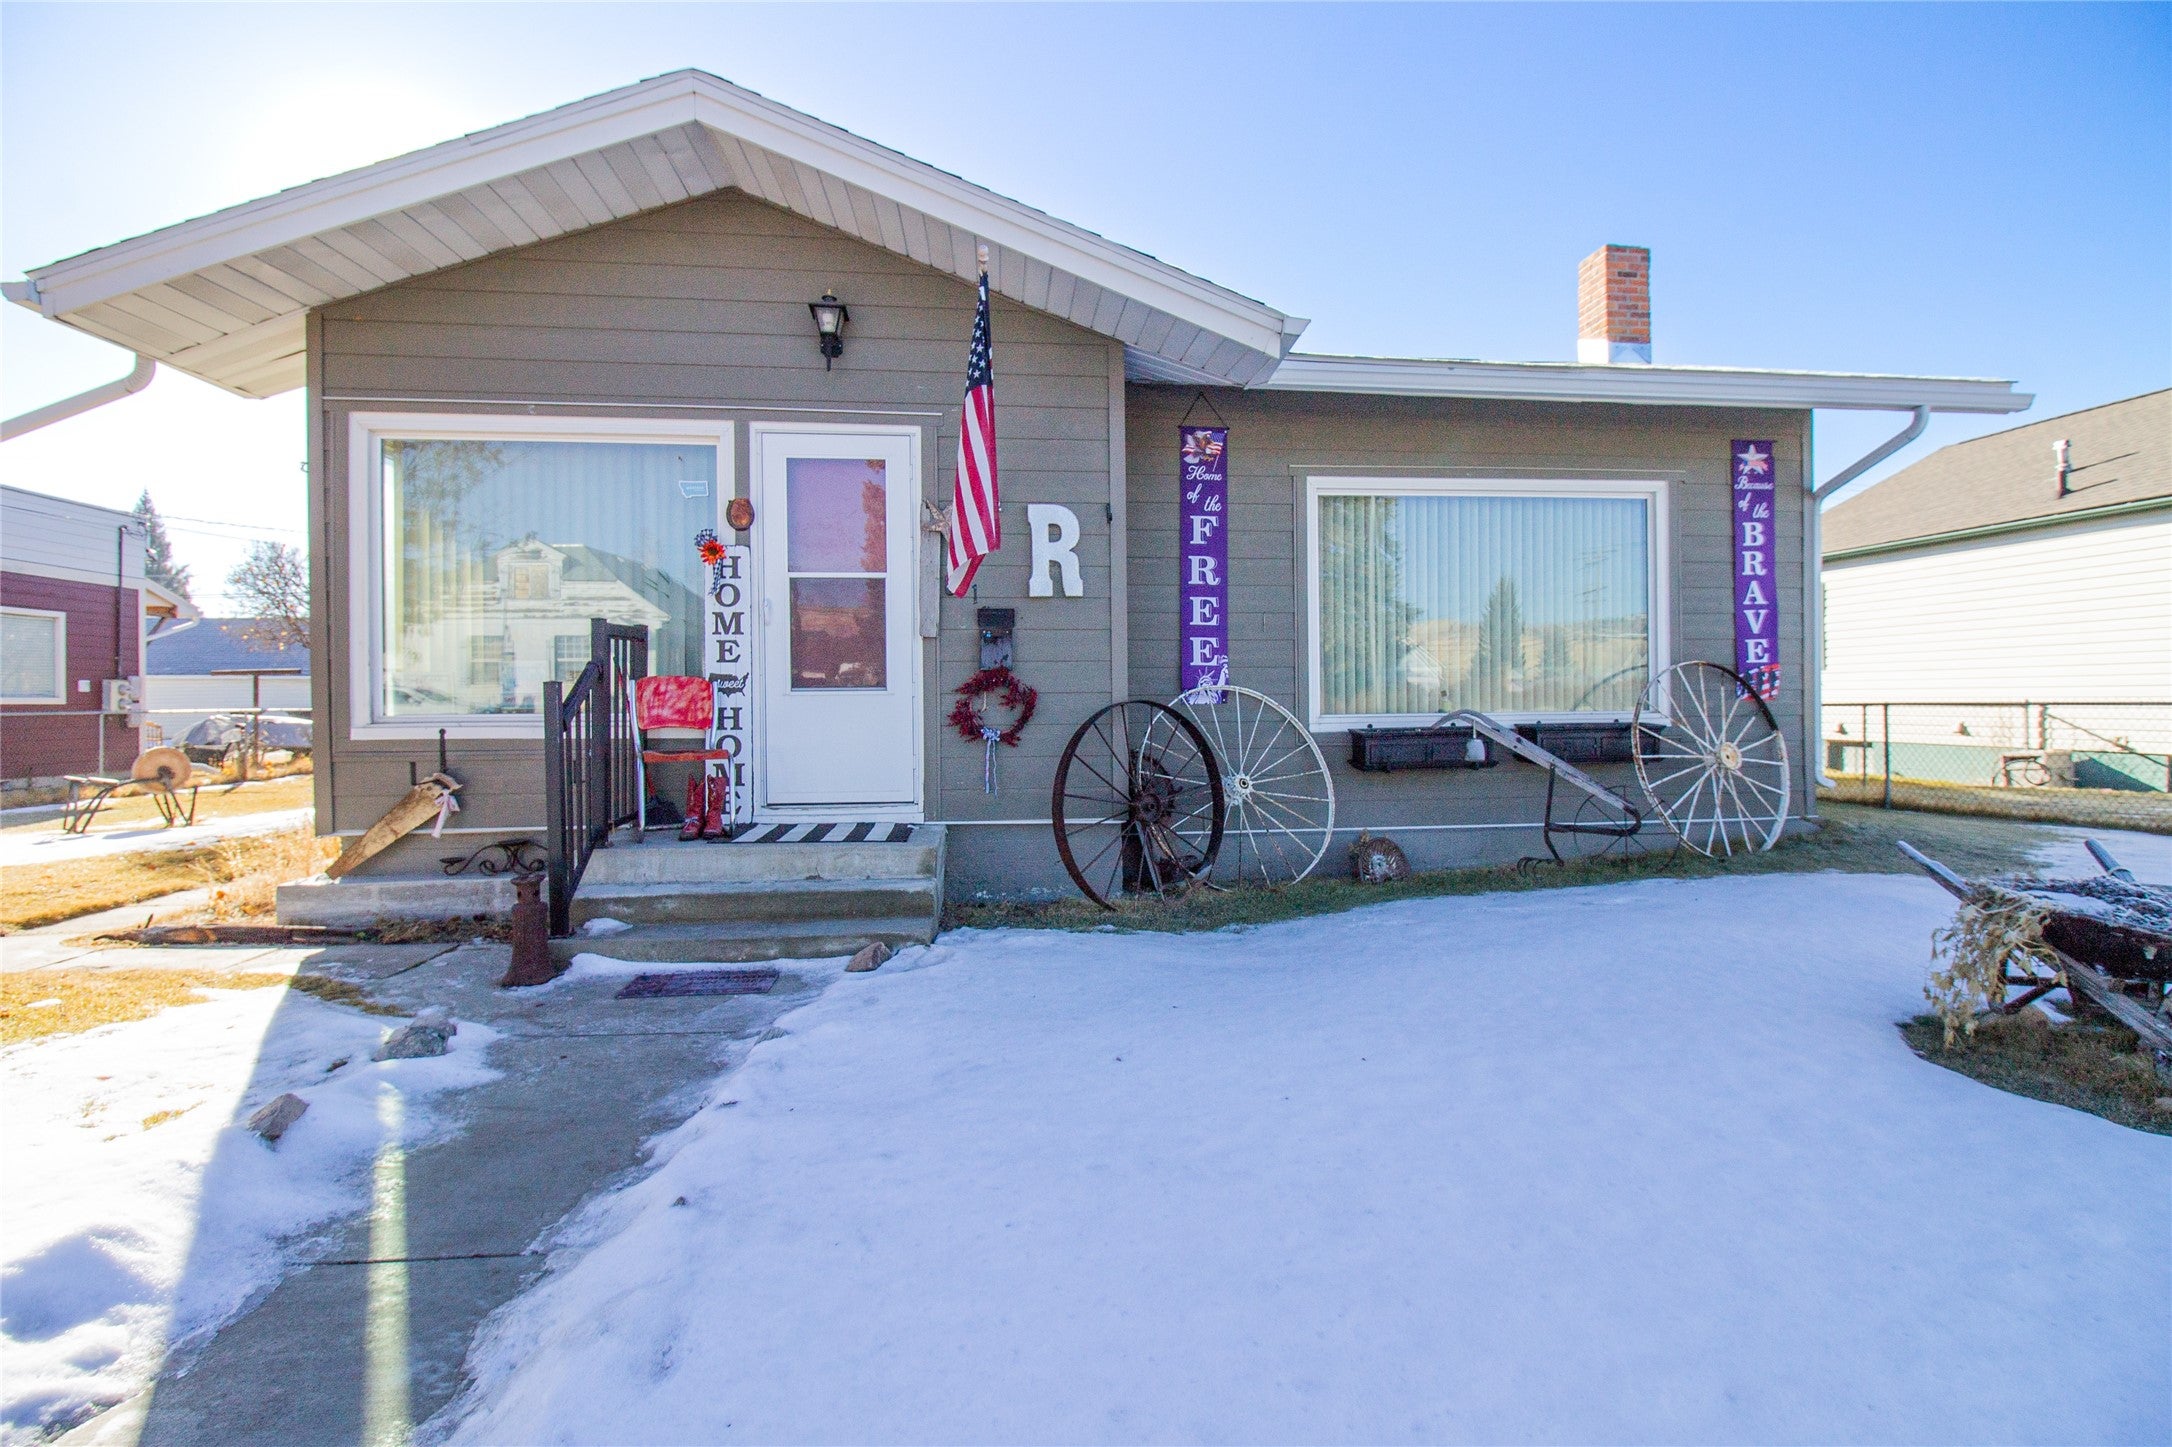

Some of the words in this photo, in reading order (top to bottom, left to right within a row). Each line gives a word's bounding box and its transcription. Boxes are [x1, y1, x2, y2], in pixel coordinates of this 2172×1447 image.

[1186, 465, 1222, 481] Home
[1186, 483, 1202, 504] of
[1204, 495, 1222, 512] the
[1738, 491, 1752, 512] of
[1752, 502, 1770, 518] the
[1028, 503, 1084, 597] R
[1188, 515, 1221, 666] FREE
[1742, 521, 1769, 663] BRAVE
[712, 555, 744, 663] HOME
